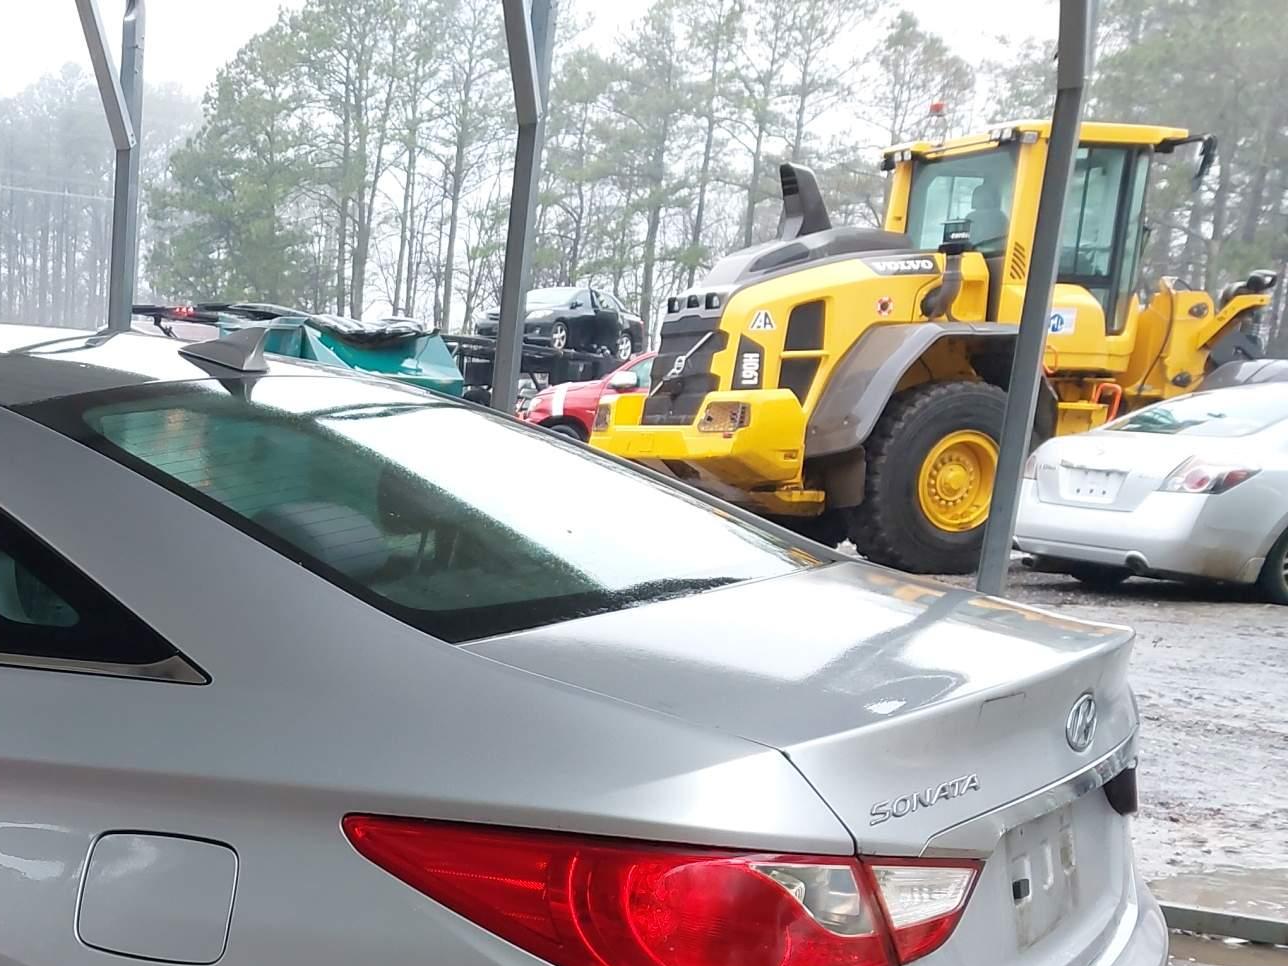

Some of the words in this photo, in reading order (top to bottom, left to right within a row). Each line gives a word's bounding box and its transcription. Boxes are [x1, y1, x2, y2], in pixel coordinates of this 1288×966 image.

[871, 259, 934, 271] VOLVO
[741, 352, 760, 386] L90H
[870, 773, 981, 827] SONATA
